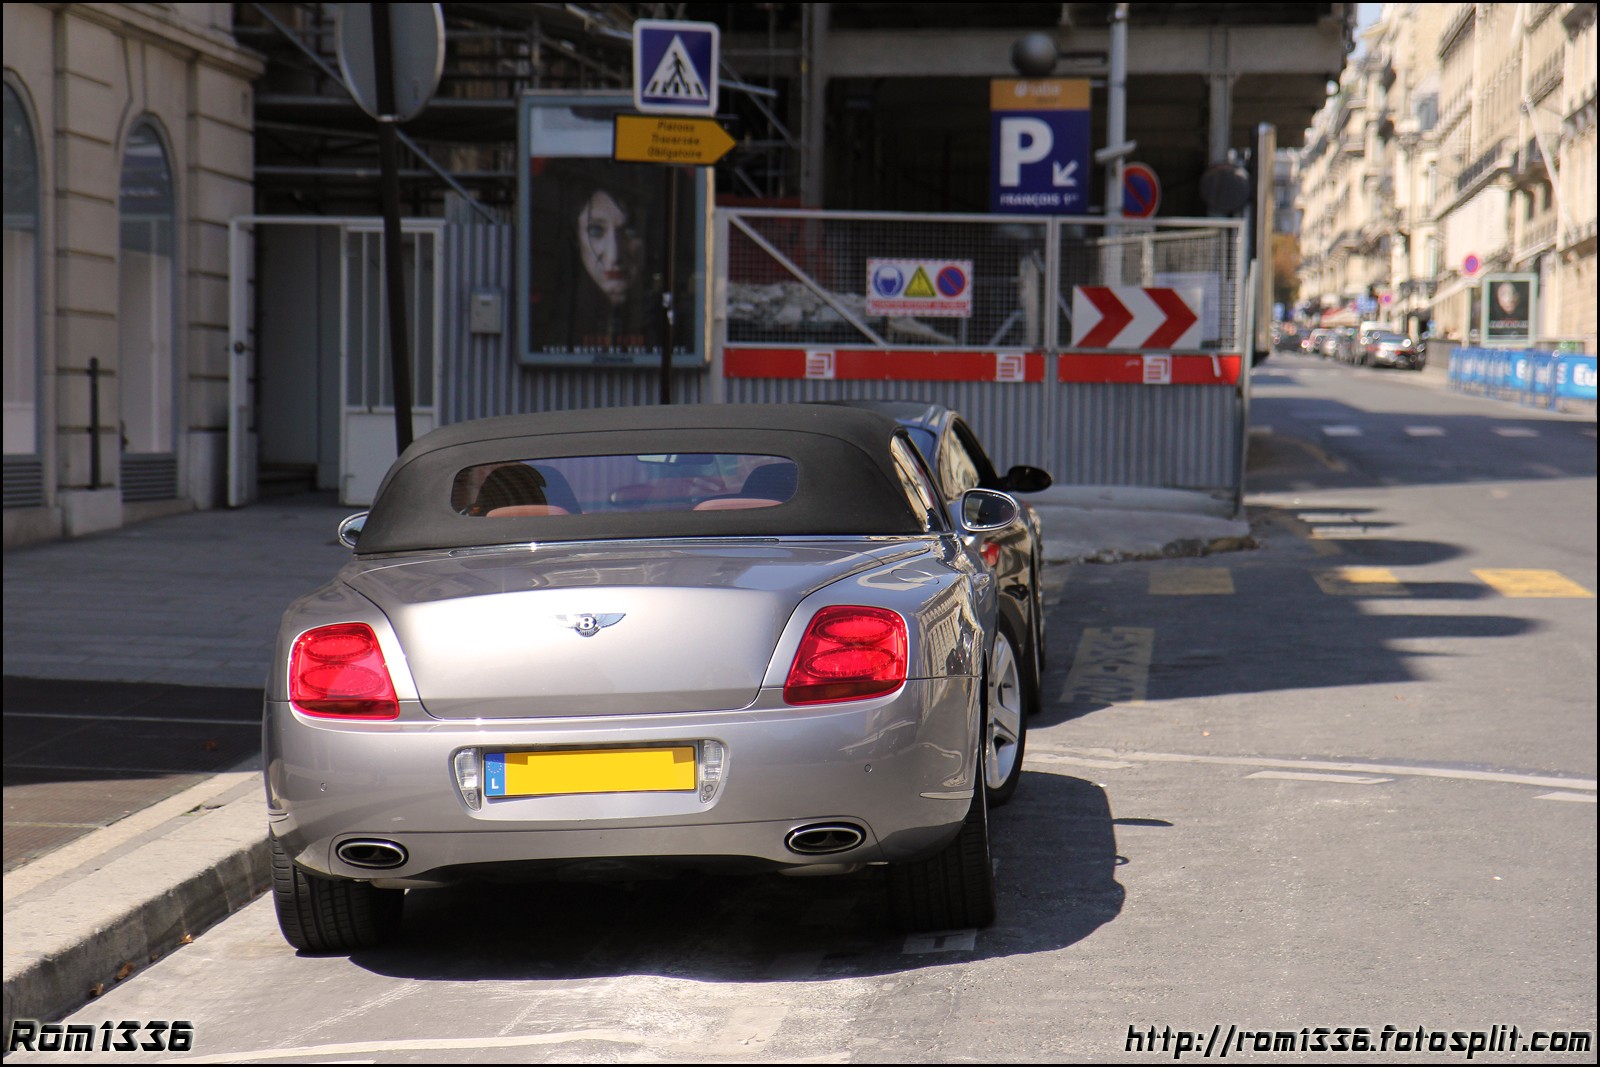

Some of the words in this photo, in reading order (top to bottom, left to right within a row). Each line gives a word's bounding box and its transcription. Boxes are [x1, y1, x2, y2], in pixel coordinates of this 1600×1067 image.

[1000, 117, 1054, 187] P
[1000, 192, 1061, 208] FRANÇOIS
[491, 778, 499, 790] L
